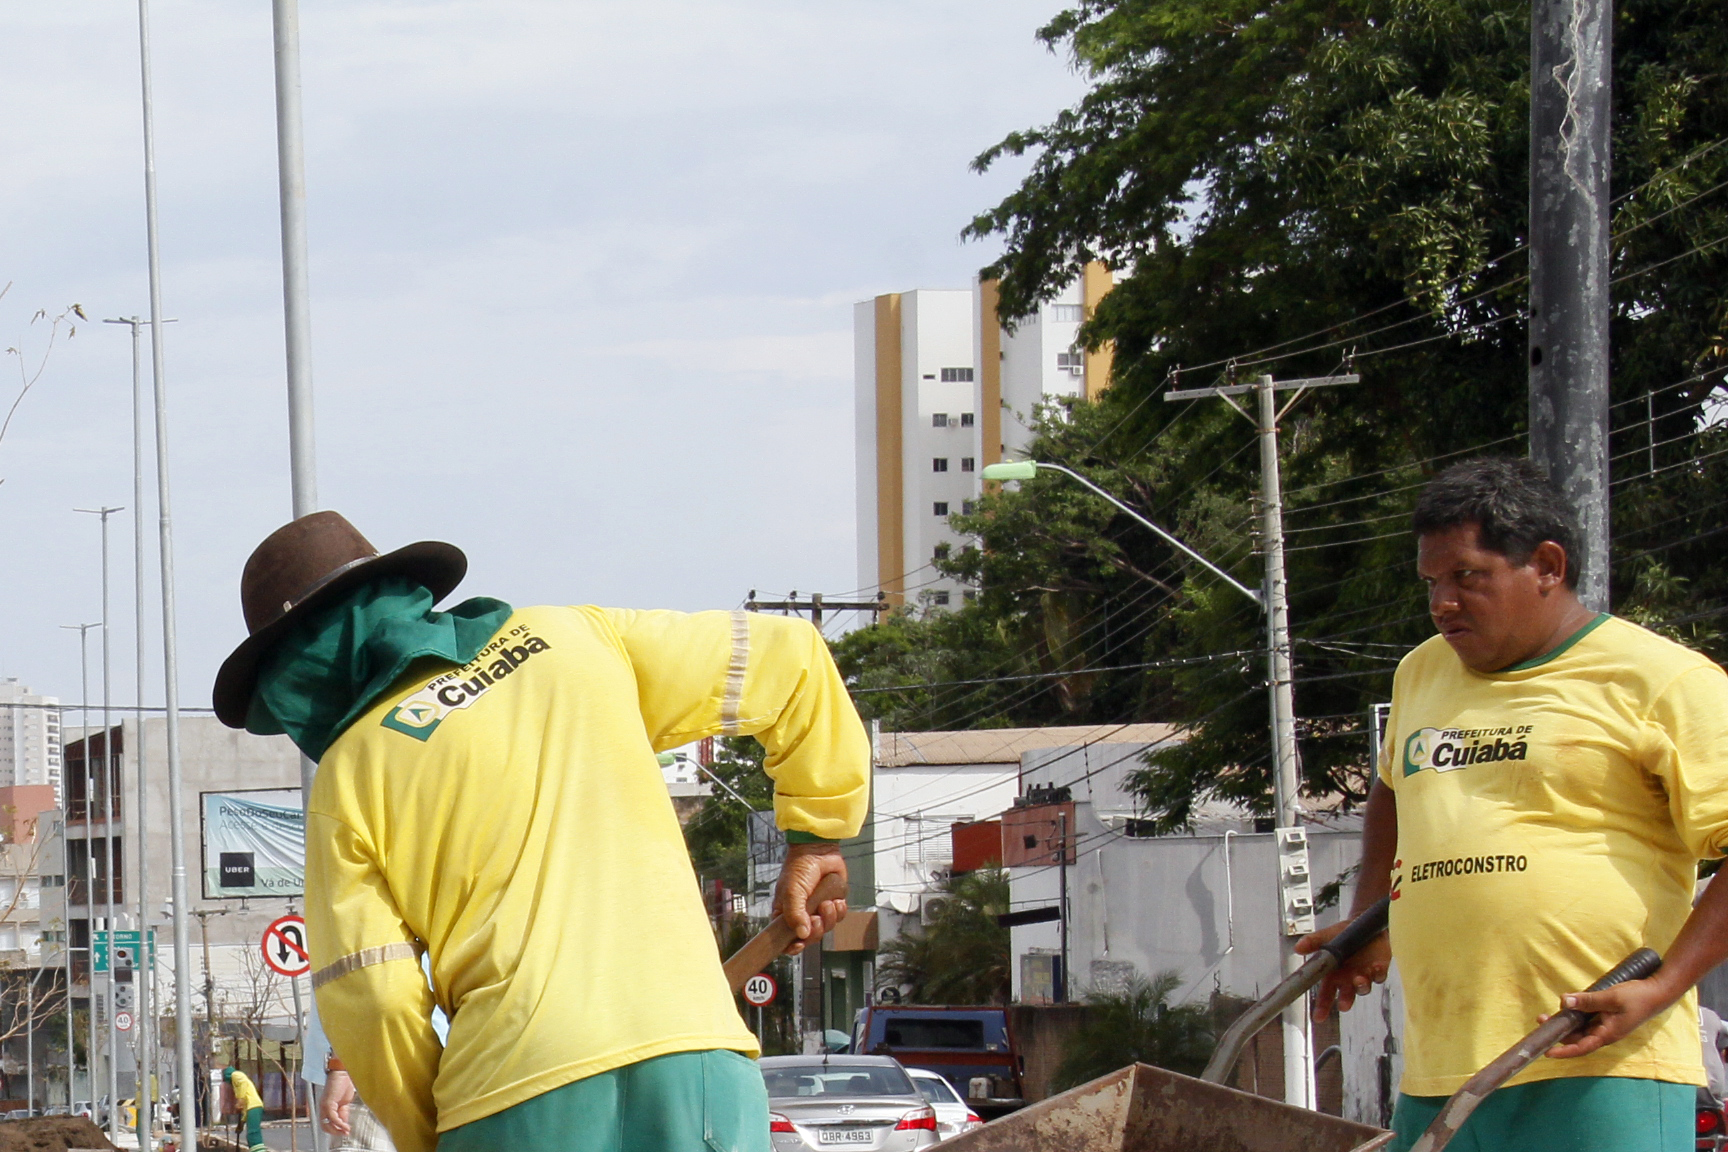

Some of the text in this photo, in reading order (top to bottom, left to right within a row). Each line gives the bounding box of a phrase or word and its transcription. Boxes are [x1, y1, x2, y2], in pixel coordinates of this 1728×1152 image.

[427, 623, 530, 691] PREFEITURA DE
[437, 632, 552, 707] Cuiabá
[1441, 725, 1533, 740] PREFEITURA DE
[1432, 735, 1528, 768] Cuiabá
[1411, 855, 1528, 883] ELETROCONSTRO
[277, 878, 291, 888] de
[747, 979, 768, 994] 40
[117, 1016, 129, 1025] 40
